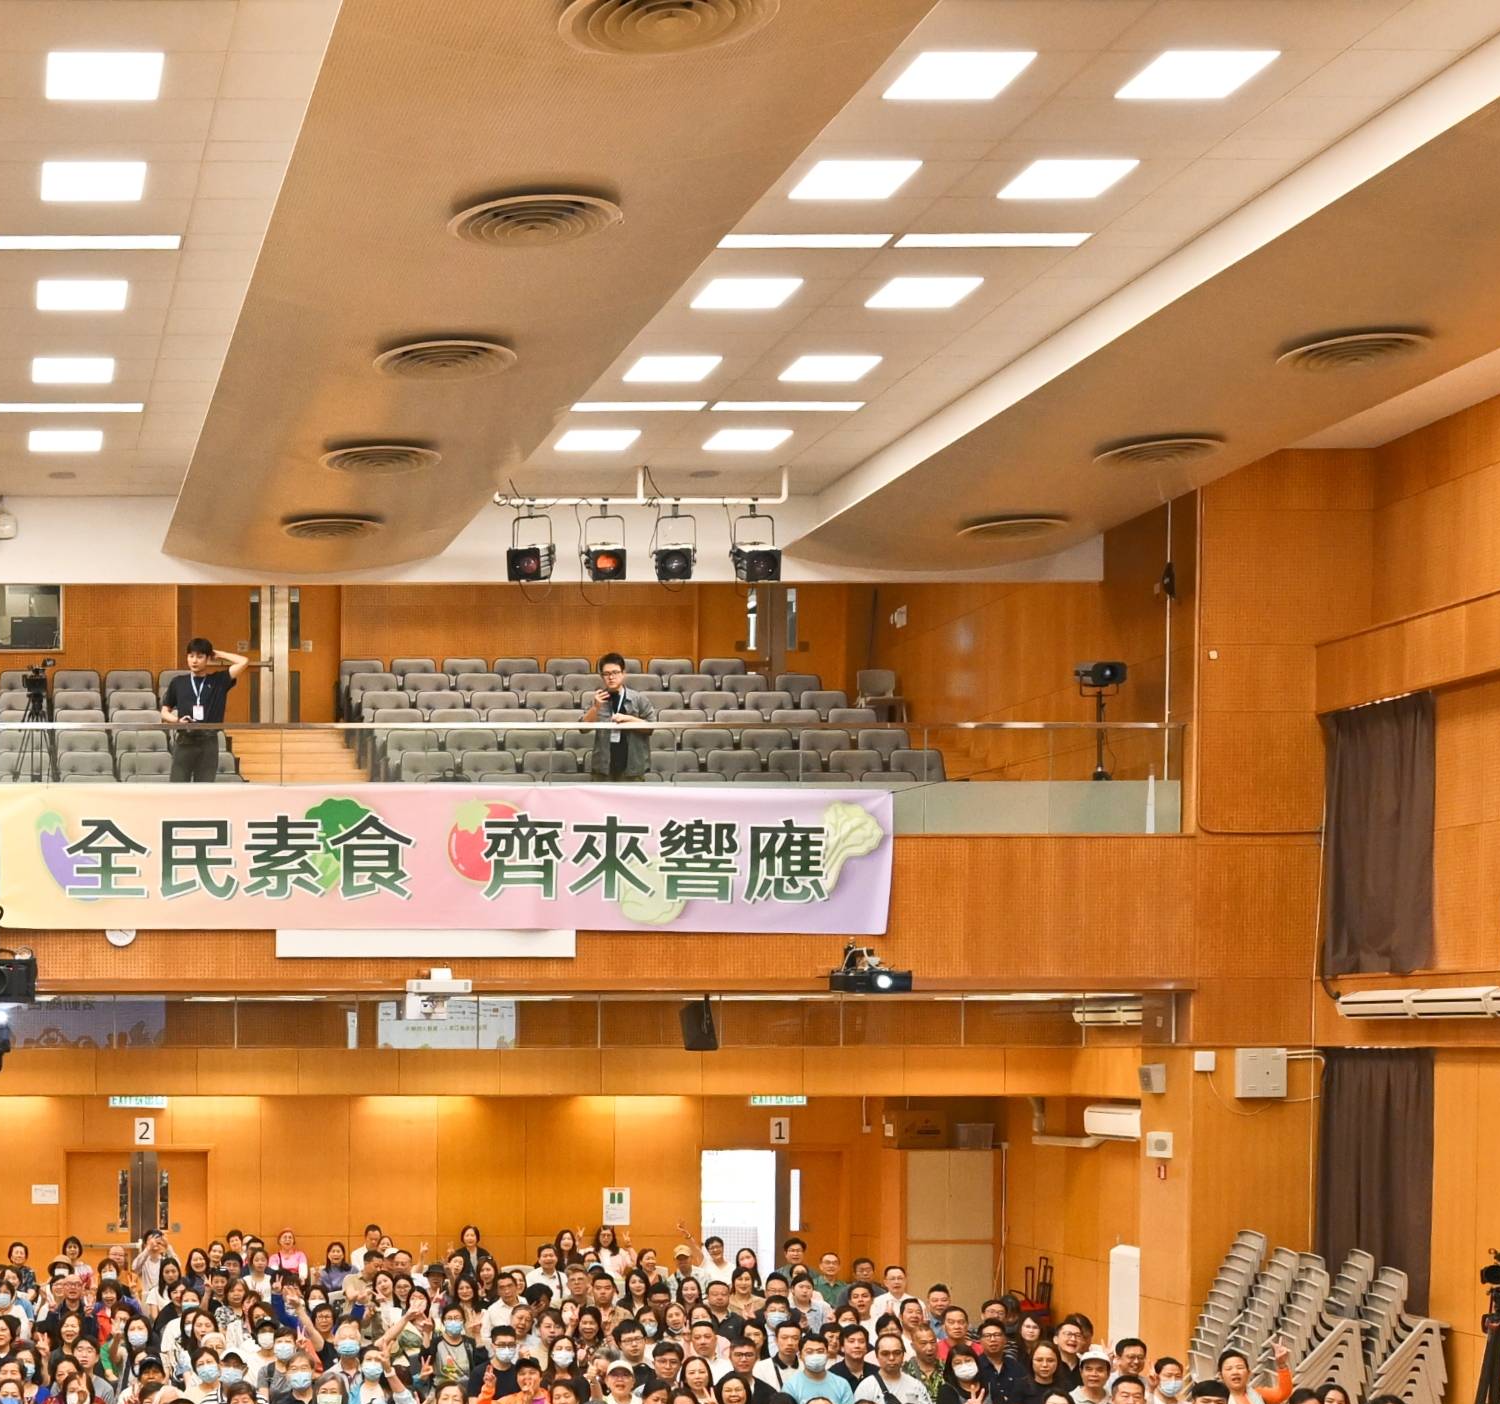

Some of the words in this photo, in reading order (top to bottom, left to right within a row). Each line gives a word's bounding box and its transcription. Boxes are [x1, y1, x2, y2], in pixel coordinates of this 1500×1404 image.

[65, 815, 416, 904] 全民素食
[482, 815, 830, 905] 齊來響應
[137, 1121, 151, 1140] 2
[774, 1121, 786, 1140] 1
